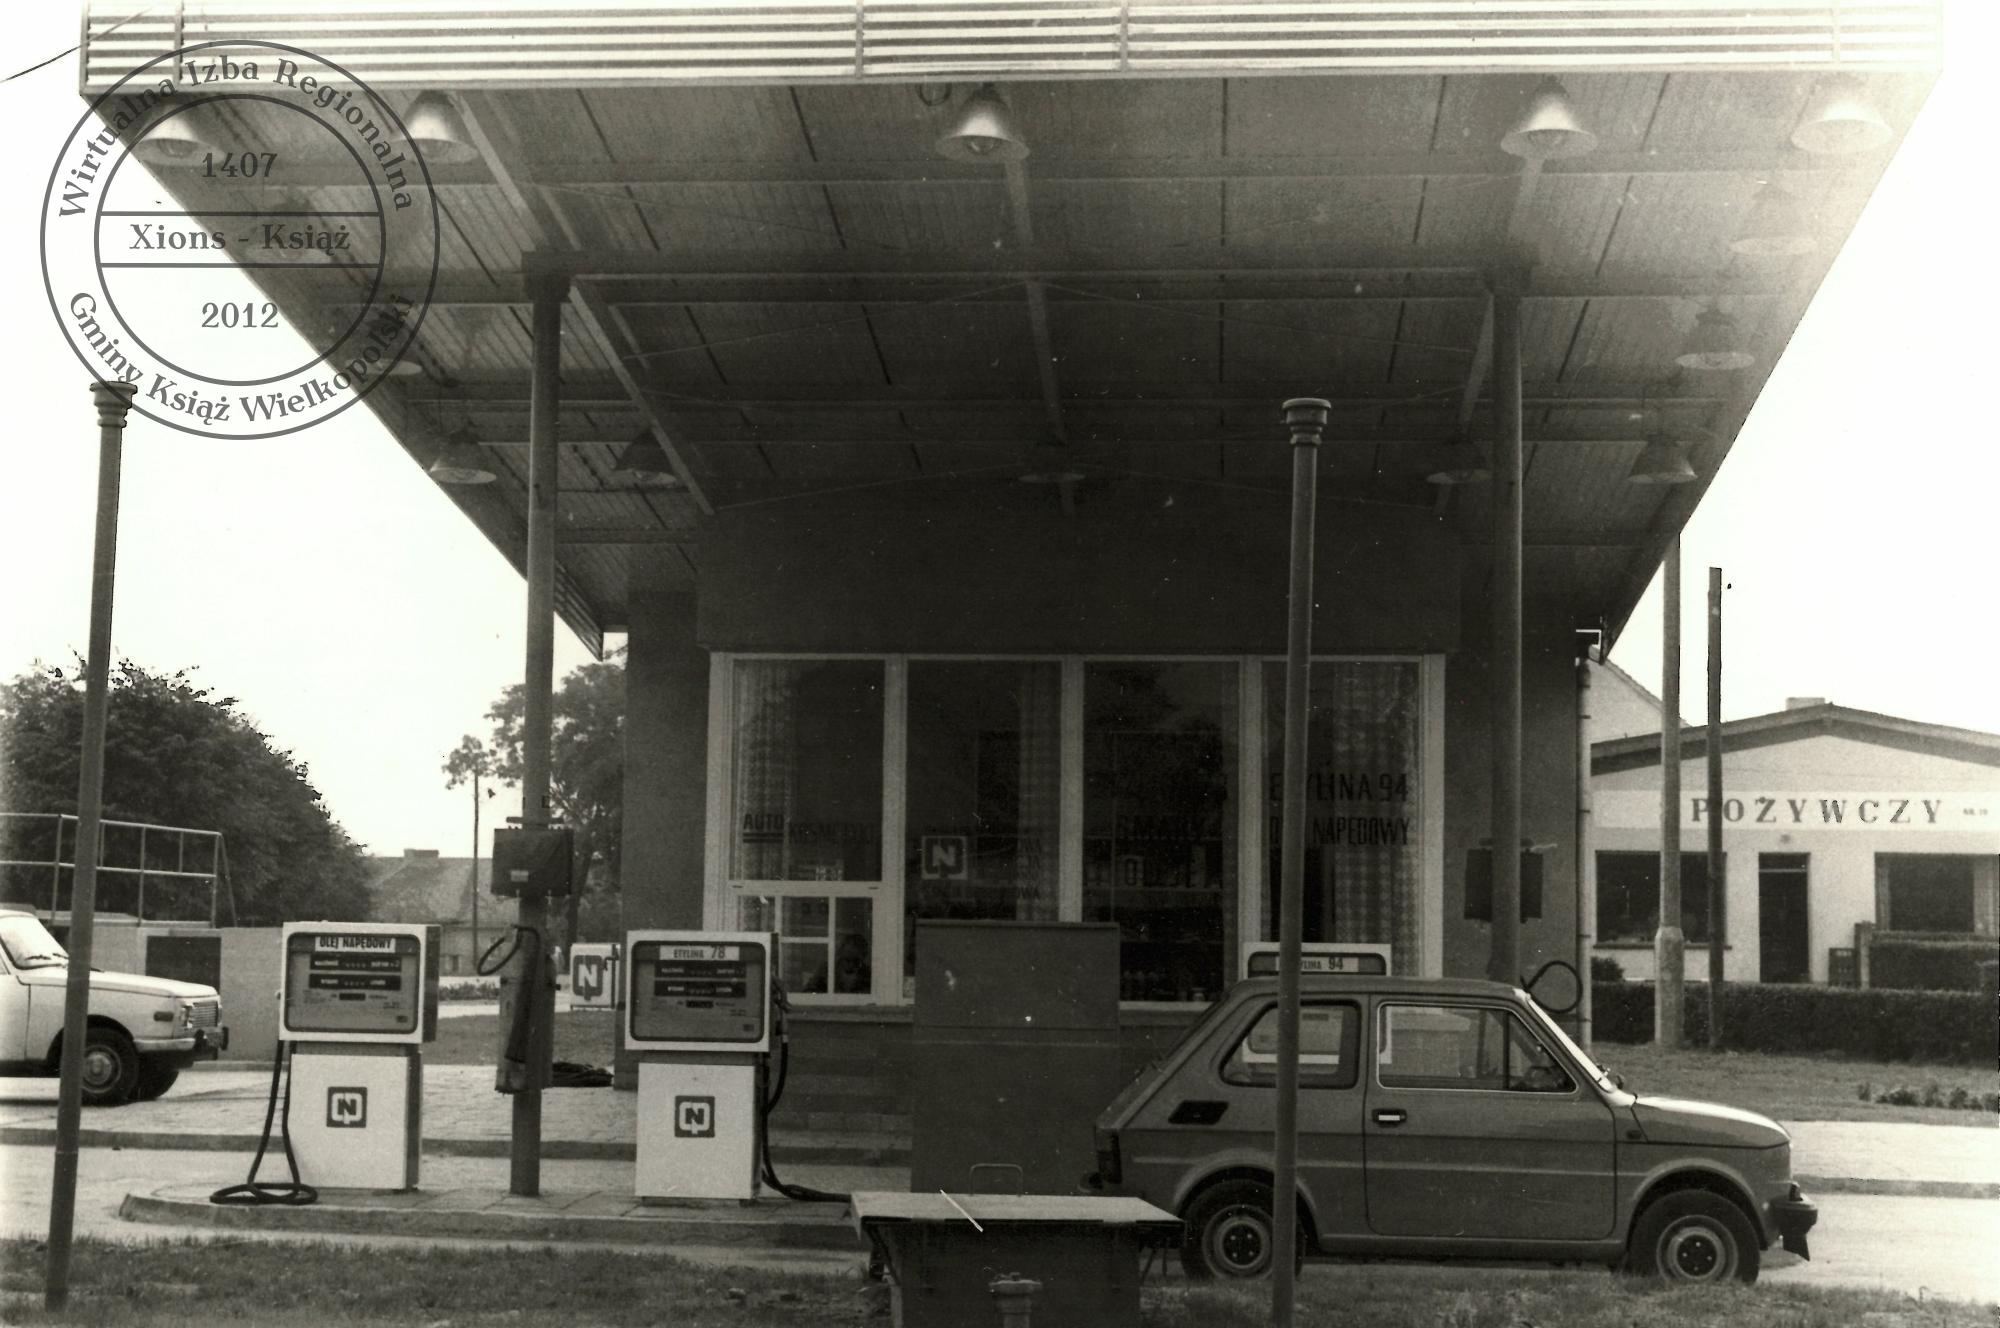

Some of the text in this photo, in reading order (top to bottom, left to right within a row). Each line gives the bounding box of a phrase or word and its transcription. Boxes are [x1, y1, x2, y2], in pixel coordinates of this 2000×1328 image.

[1269, 772, 1409, 802] EYLINA 94
[1660, 796, 1942, 824] POŻYWCZY
[743, 813, 784, 830] AUTO
[319, 937, 339, 949] OLEJ
[673, 945, 725, 959] ETYLINA 78
[1328, 956, 1343, 970] 94
